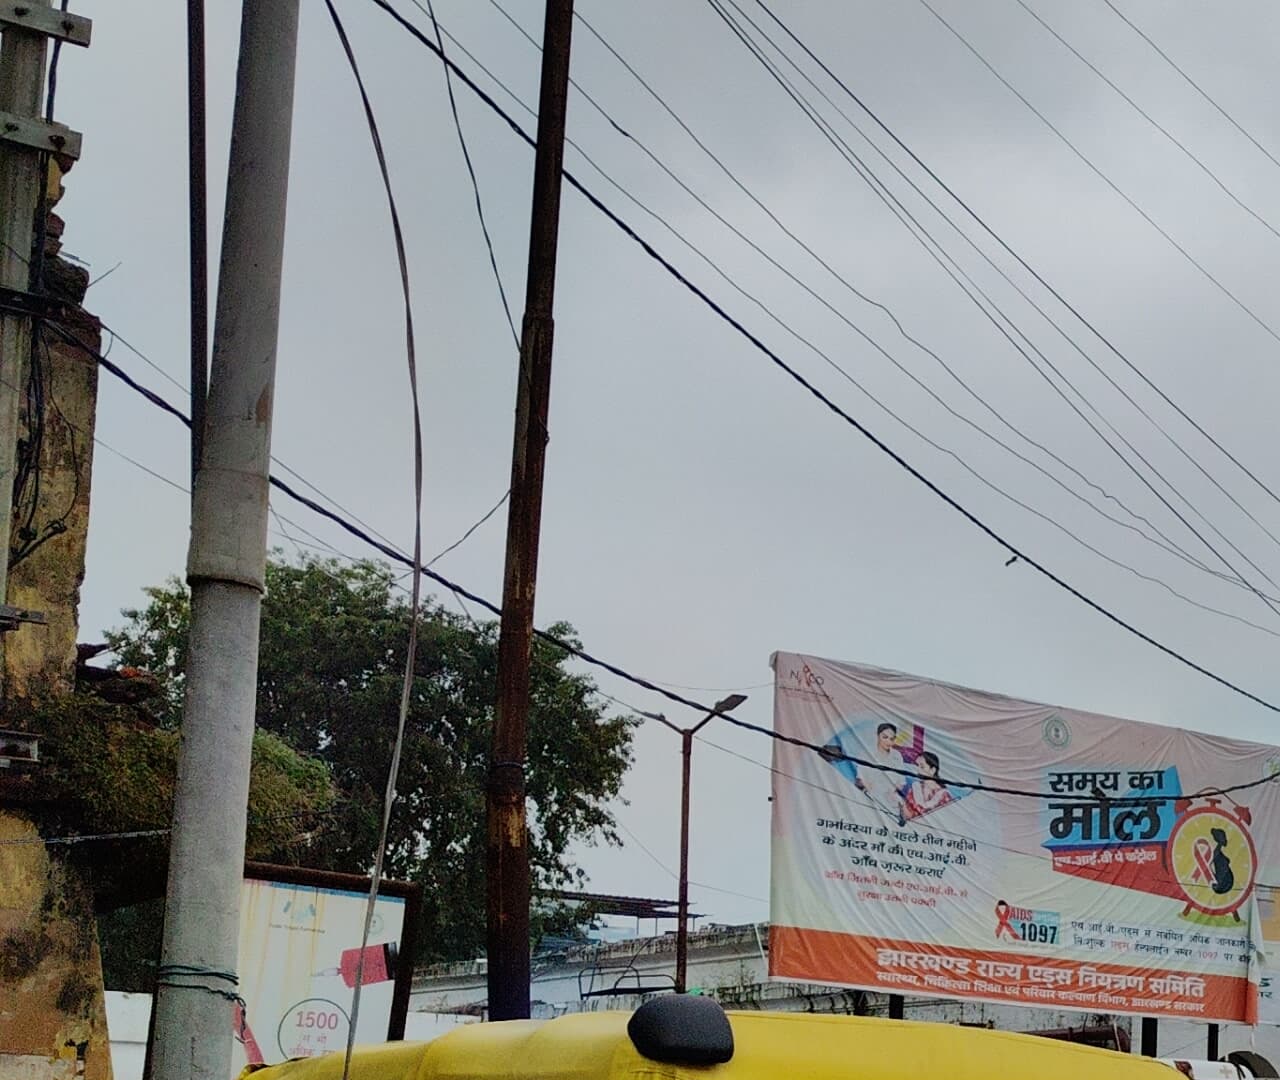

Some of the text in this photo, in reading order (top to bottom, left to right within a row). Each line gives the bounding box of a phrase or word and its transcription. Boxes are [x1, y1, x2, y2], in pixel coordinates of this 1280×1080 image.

[1048, 769, 1166, 793] समय का
[1047, 788, 1167, 841] मोल
[838, 836, 869, 850] अंदर
[921, 832, 945, 848] तीन
[1020, 922, 1058, 945] 1097
[975, 958, 1025, 981] राज्य
[1026, 965, 1074, 989] एड्स
[1149, 974, 1207, 999] समिति
[295, 1010, 339, 1031] 1500
